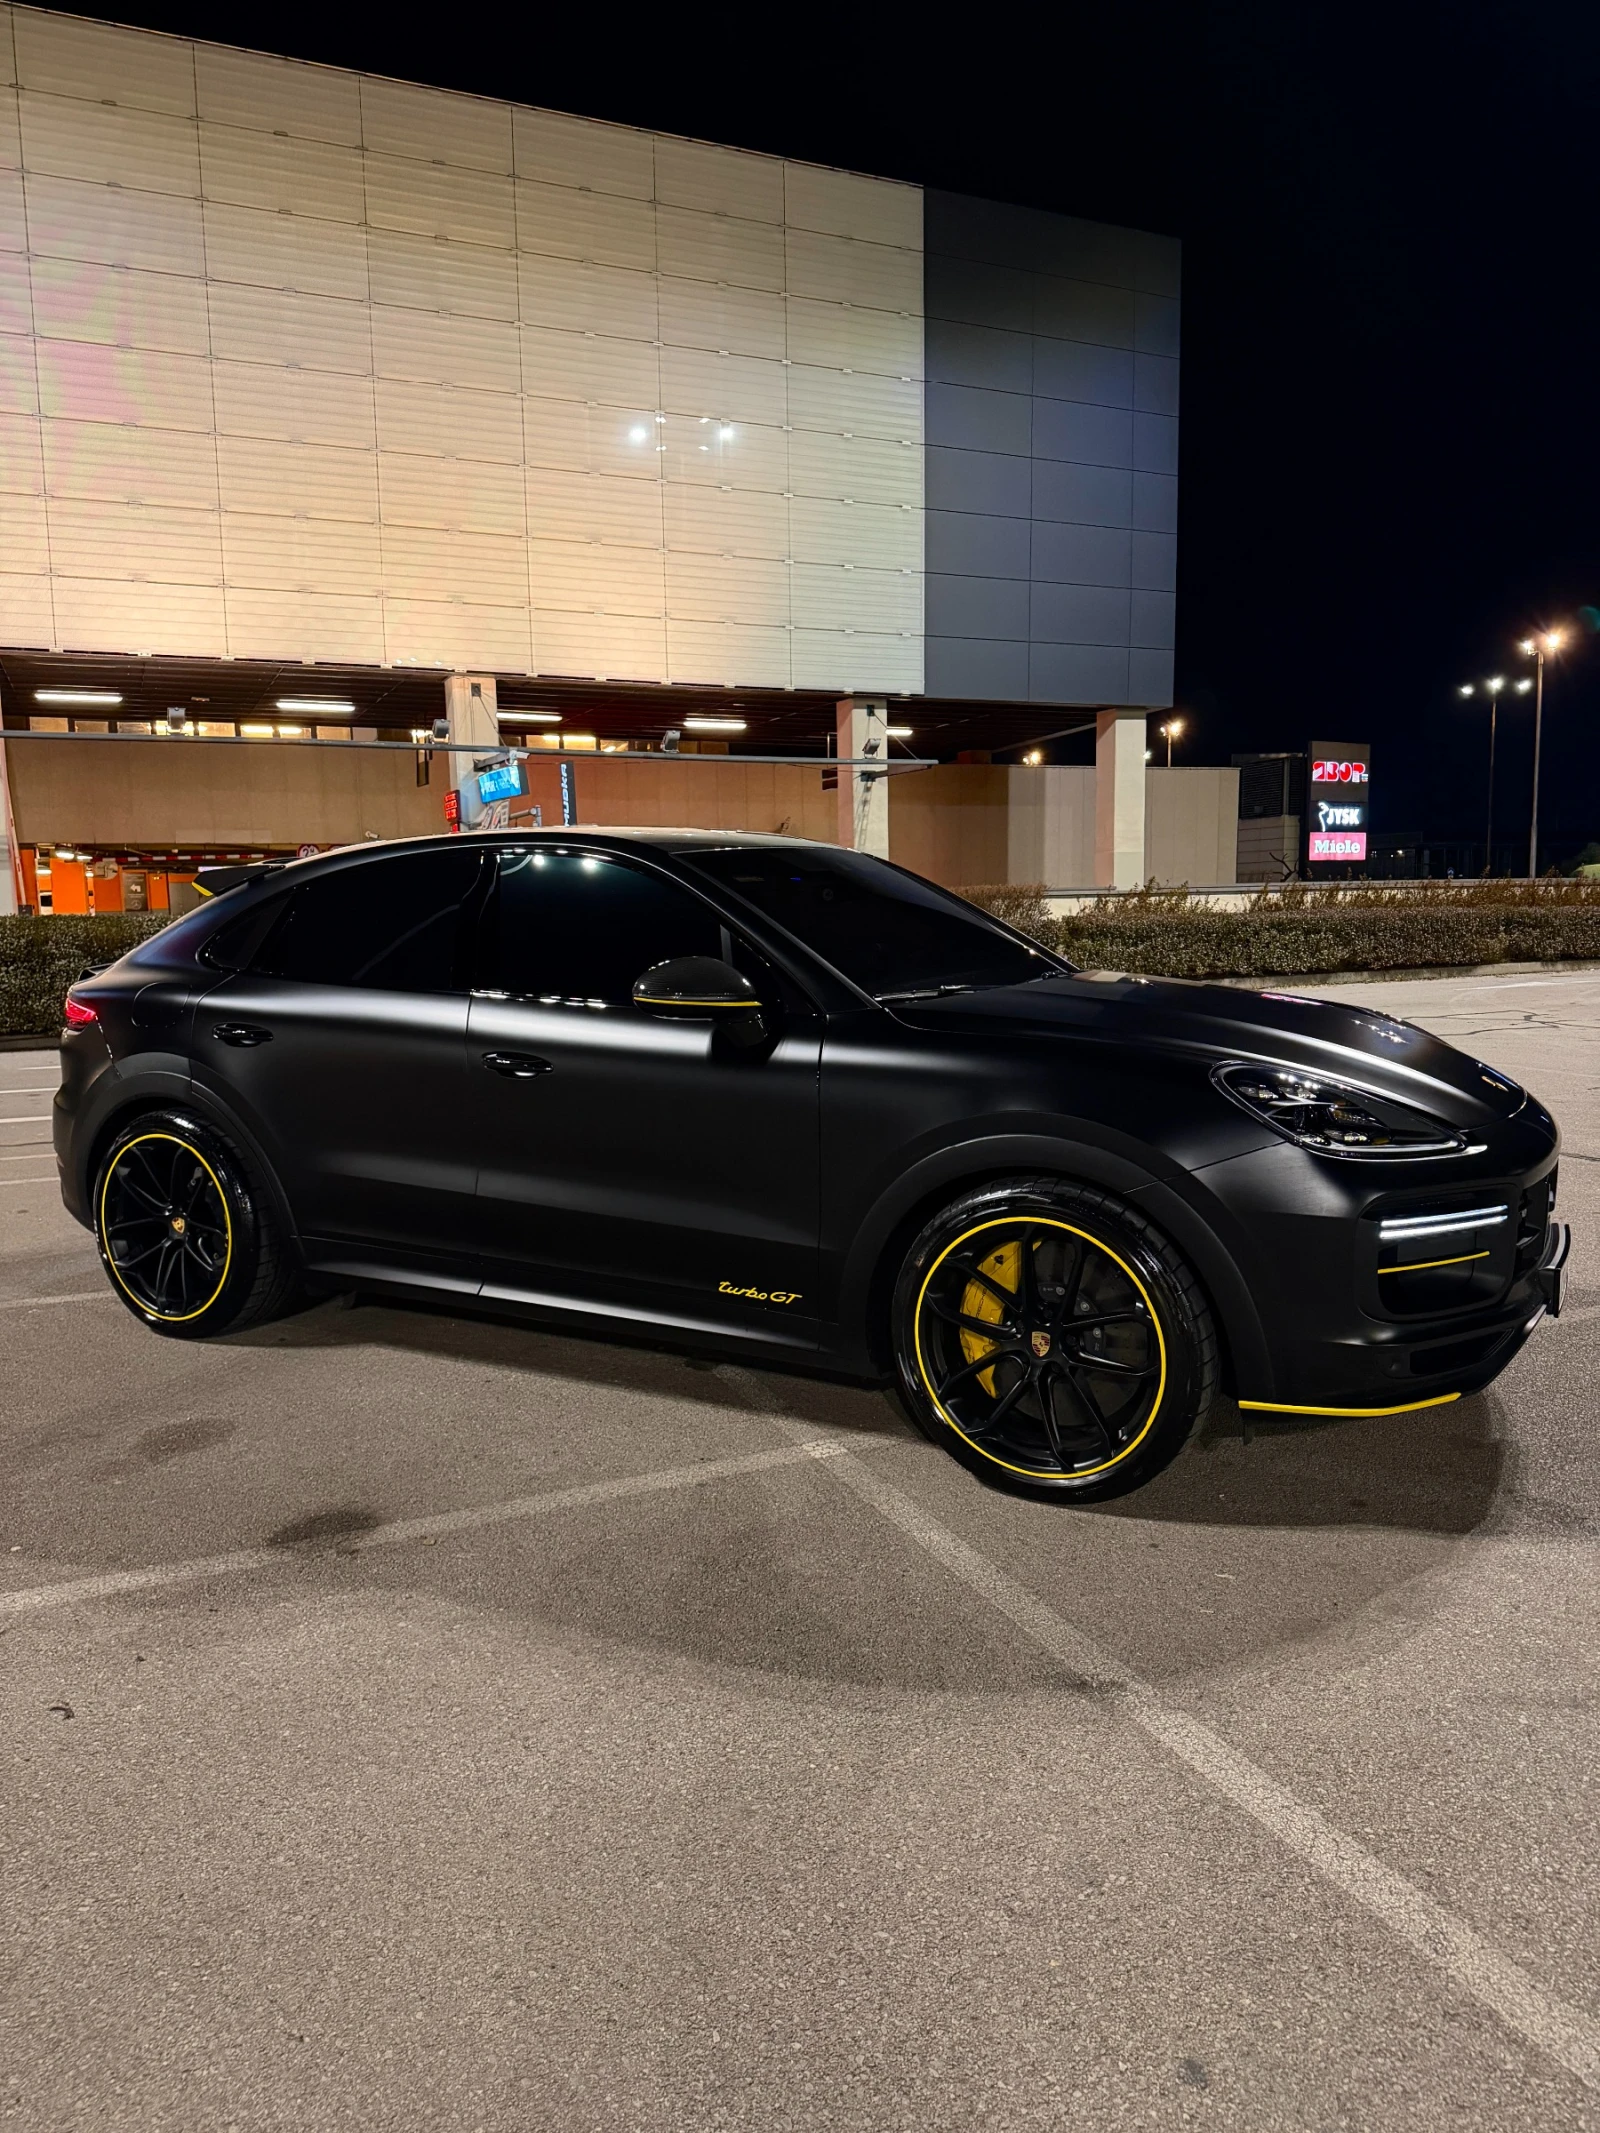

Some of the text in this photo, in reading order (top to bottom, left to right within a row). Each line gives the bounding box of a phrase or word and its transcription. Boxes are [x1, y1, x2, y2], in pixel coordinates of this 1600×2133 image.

[1326, 808, 1360, 825] JYSK
[1314, 839, 1361, 854] Miele
[718, 1281, 803, 1304] turbo GT
